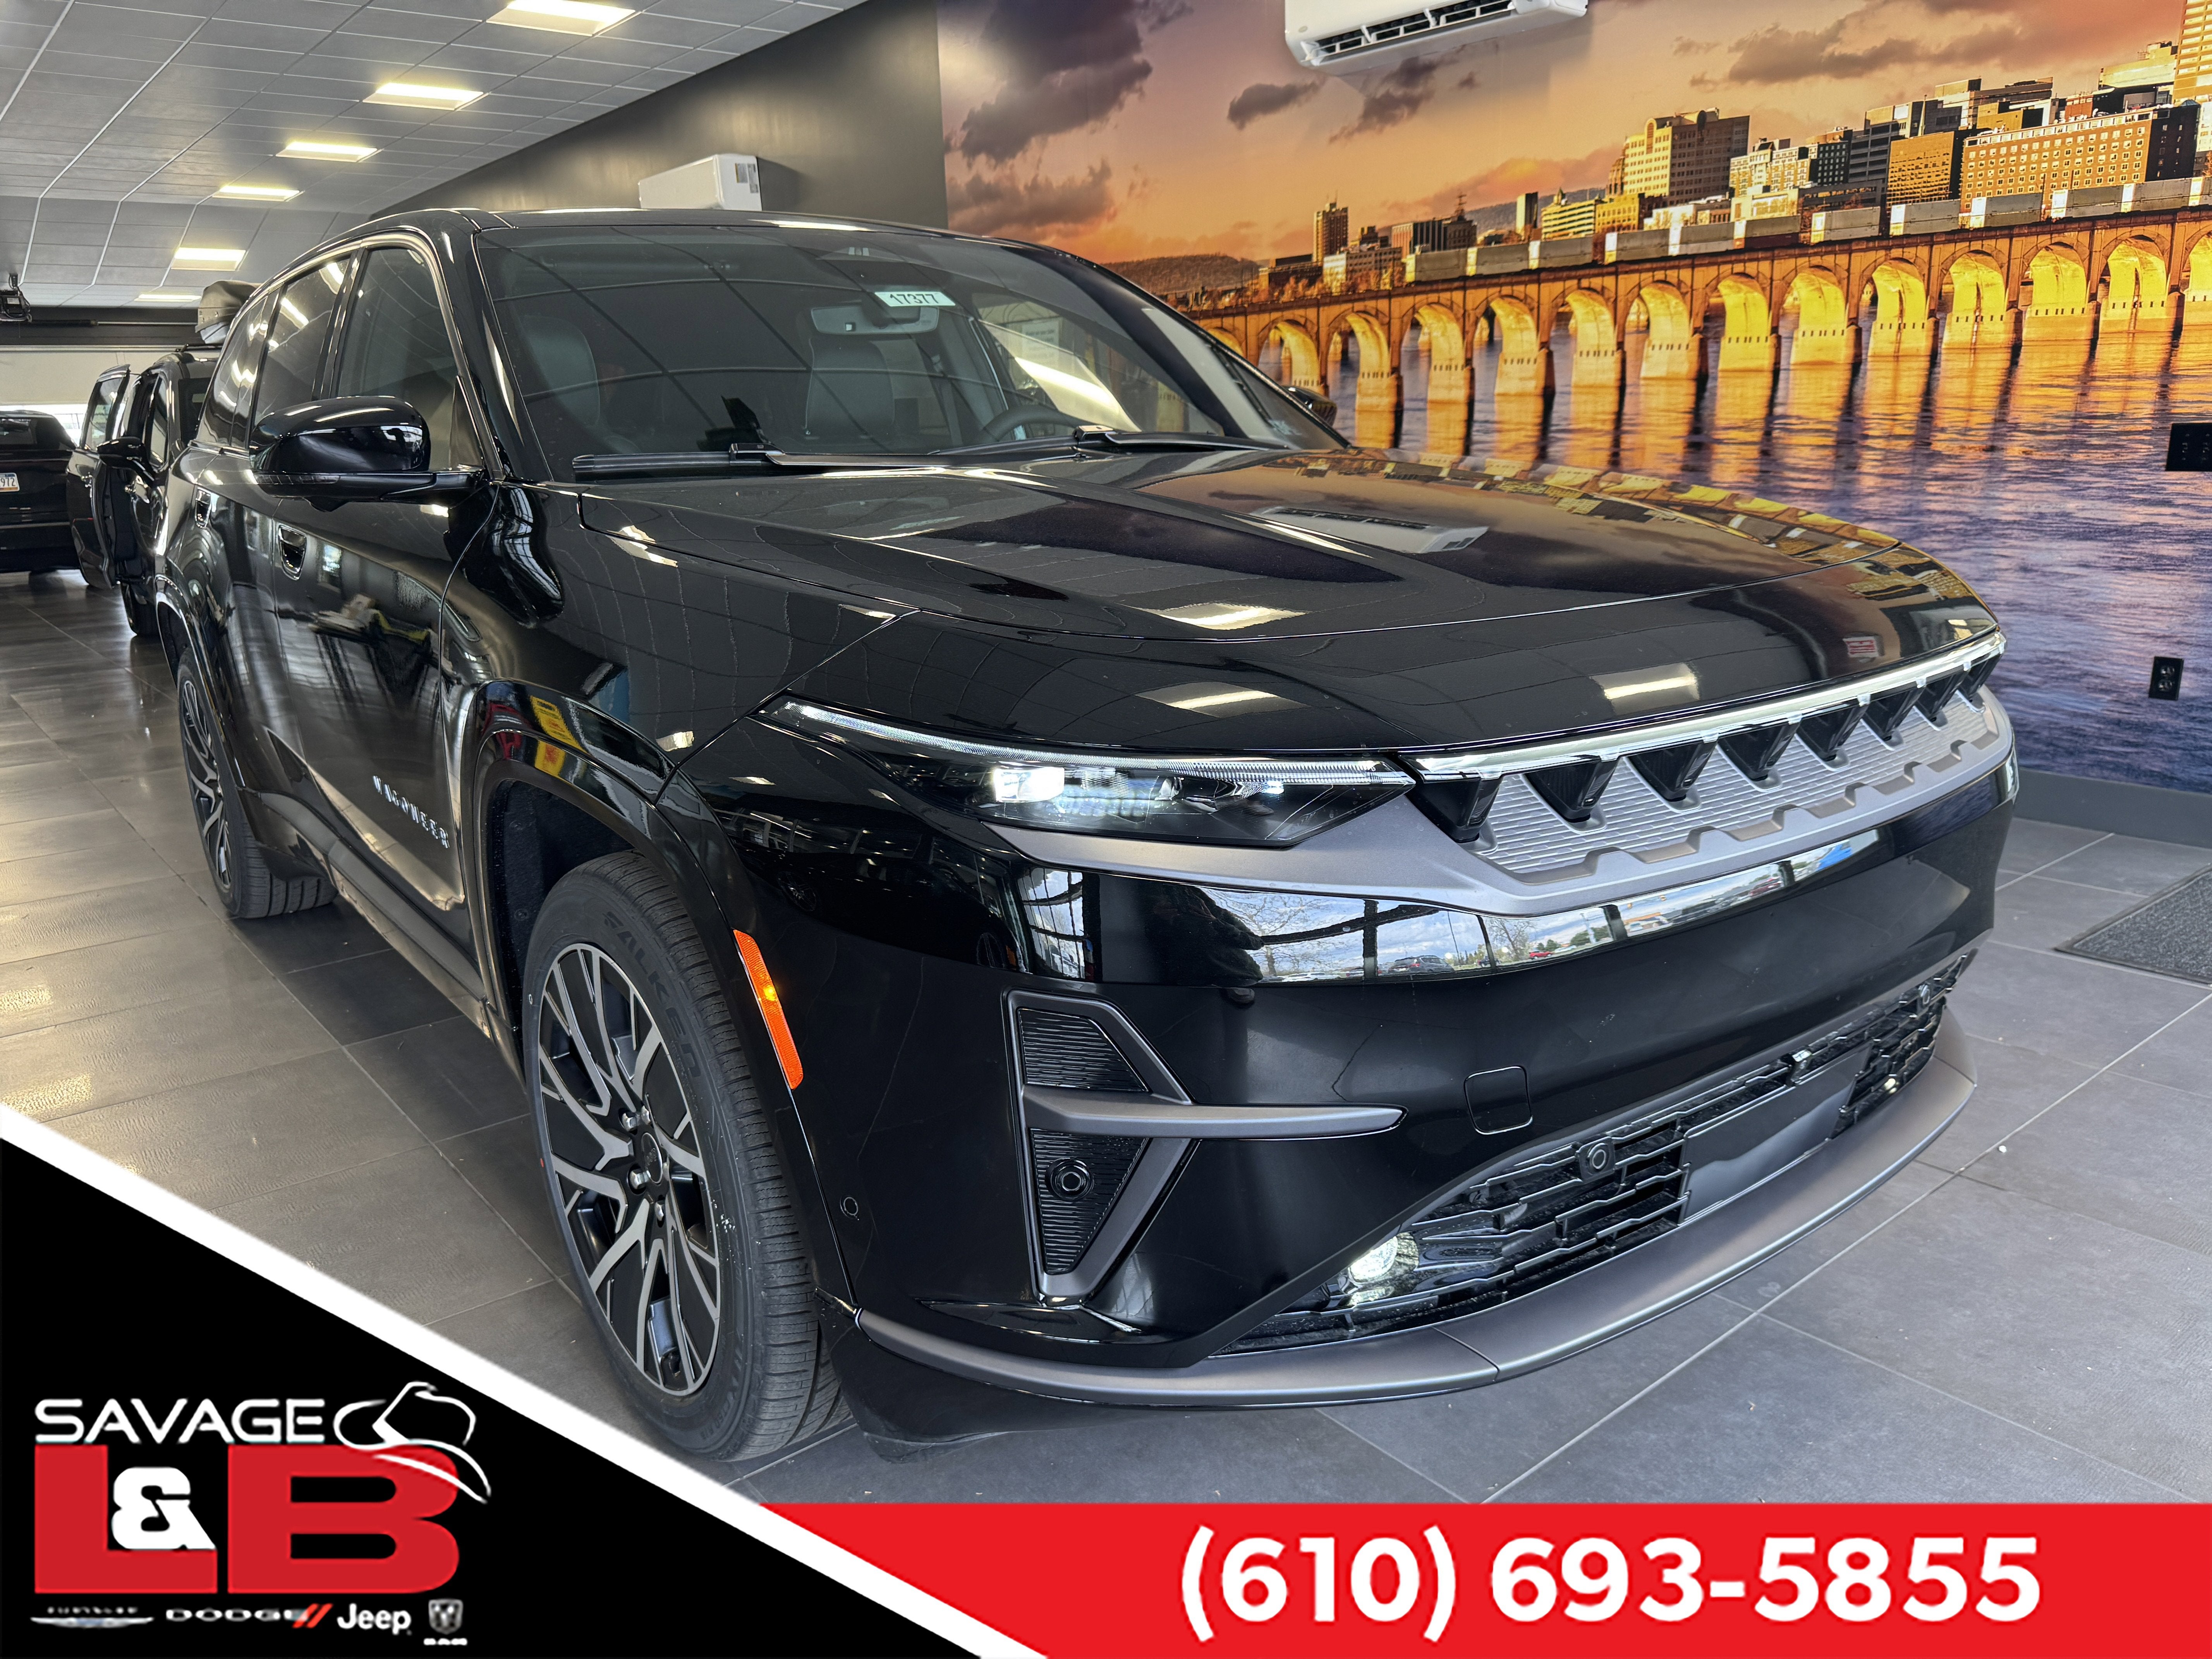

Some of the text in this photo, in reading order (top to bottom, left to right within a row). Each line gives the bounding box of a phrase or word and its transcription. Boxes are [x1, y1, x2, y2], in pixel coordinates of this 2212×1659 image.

[890, 293, 939, 304] 17377
[0, 477, 16, 487] 972
[602, 911, 701, 1078] FALKEN
